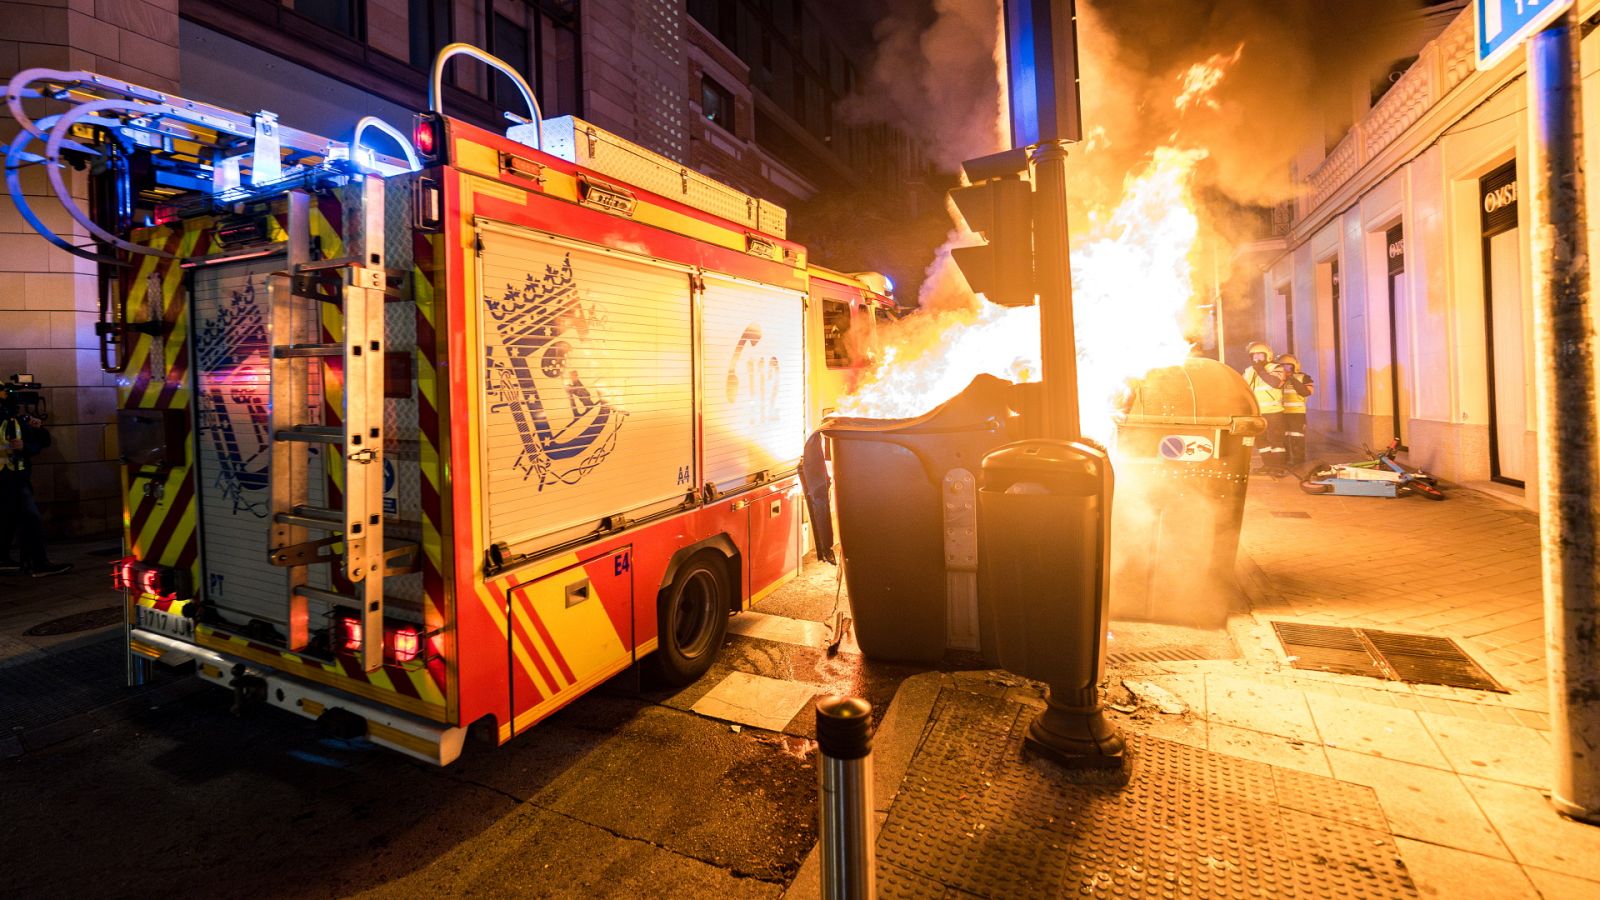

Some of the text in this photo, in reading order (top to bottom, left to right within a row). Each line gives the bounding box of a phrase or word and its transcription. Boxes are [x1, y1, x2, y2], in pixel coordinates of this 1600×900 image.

[746, 355, 781, 425] 112
[677, 465, 690, 485] A4
[614, 552, 630, 577] E4
[210, 572, 225, 597] PT
[143, 608, 168, 631] 1717
